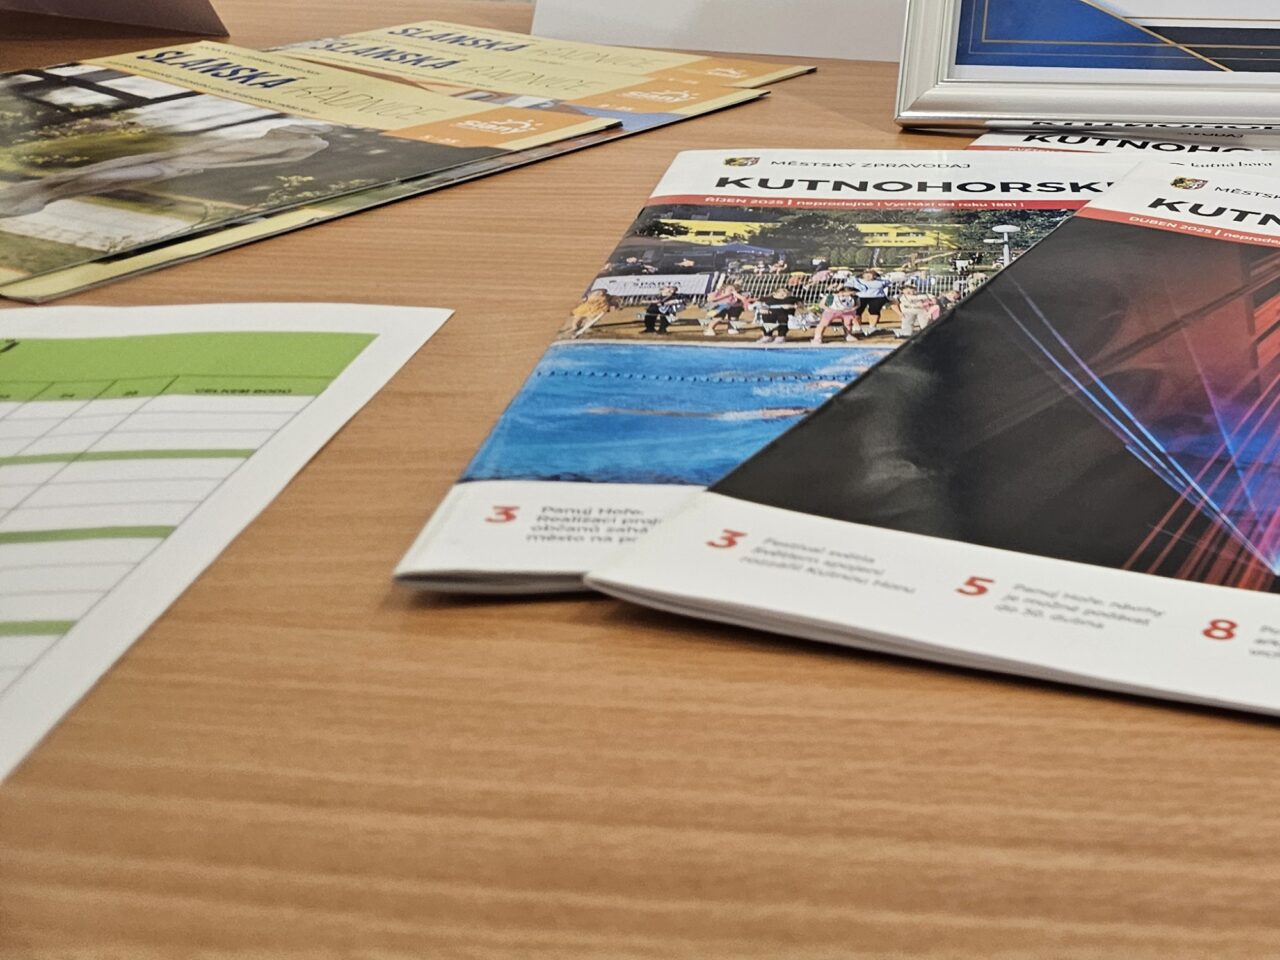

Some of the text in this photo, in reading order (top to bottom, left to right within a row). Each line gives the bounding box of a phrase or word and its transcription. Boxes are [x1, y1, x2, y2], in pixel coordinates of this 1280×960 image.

[309, 42, 467, 70] SLÁNSKÁ
[136, 49, 308, 89] SLÁNSKÁ
[771, 159, 857, 168] MĚSTSKÝ
[715, 177, 1114, 193] KUTNOHORSK
[1128, 216, 1178, 229] DUBEN
[1179, 223, 1213, 234] 2025
[485, 506, 520, 524] 3
[705, 528, 748, 549] 3
[954, 576, 996, 596] 5
[1201, 618, 1239, 641] 8
